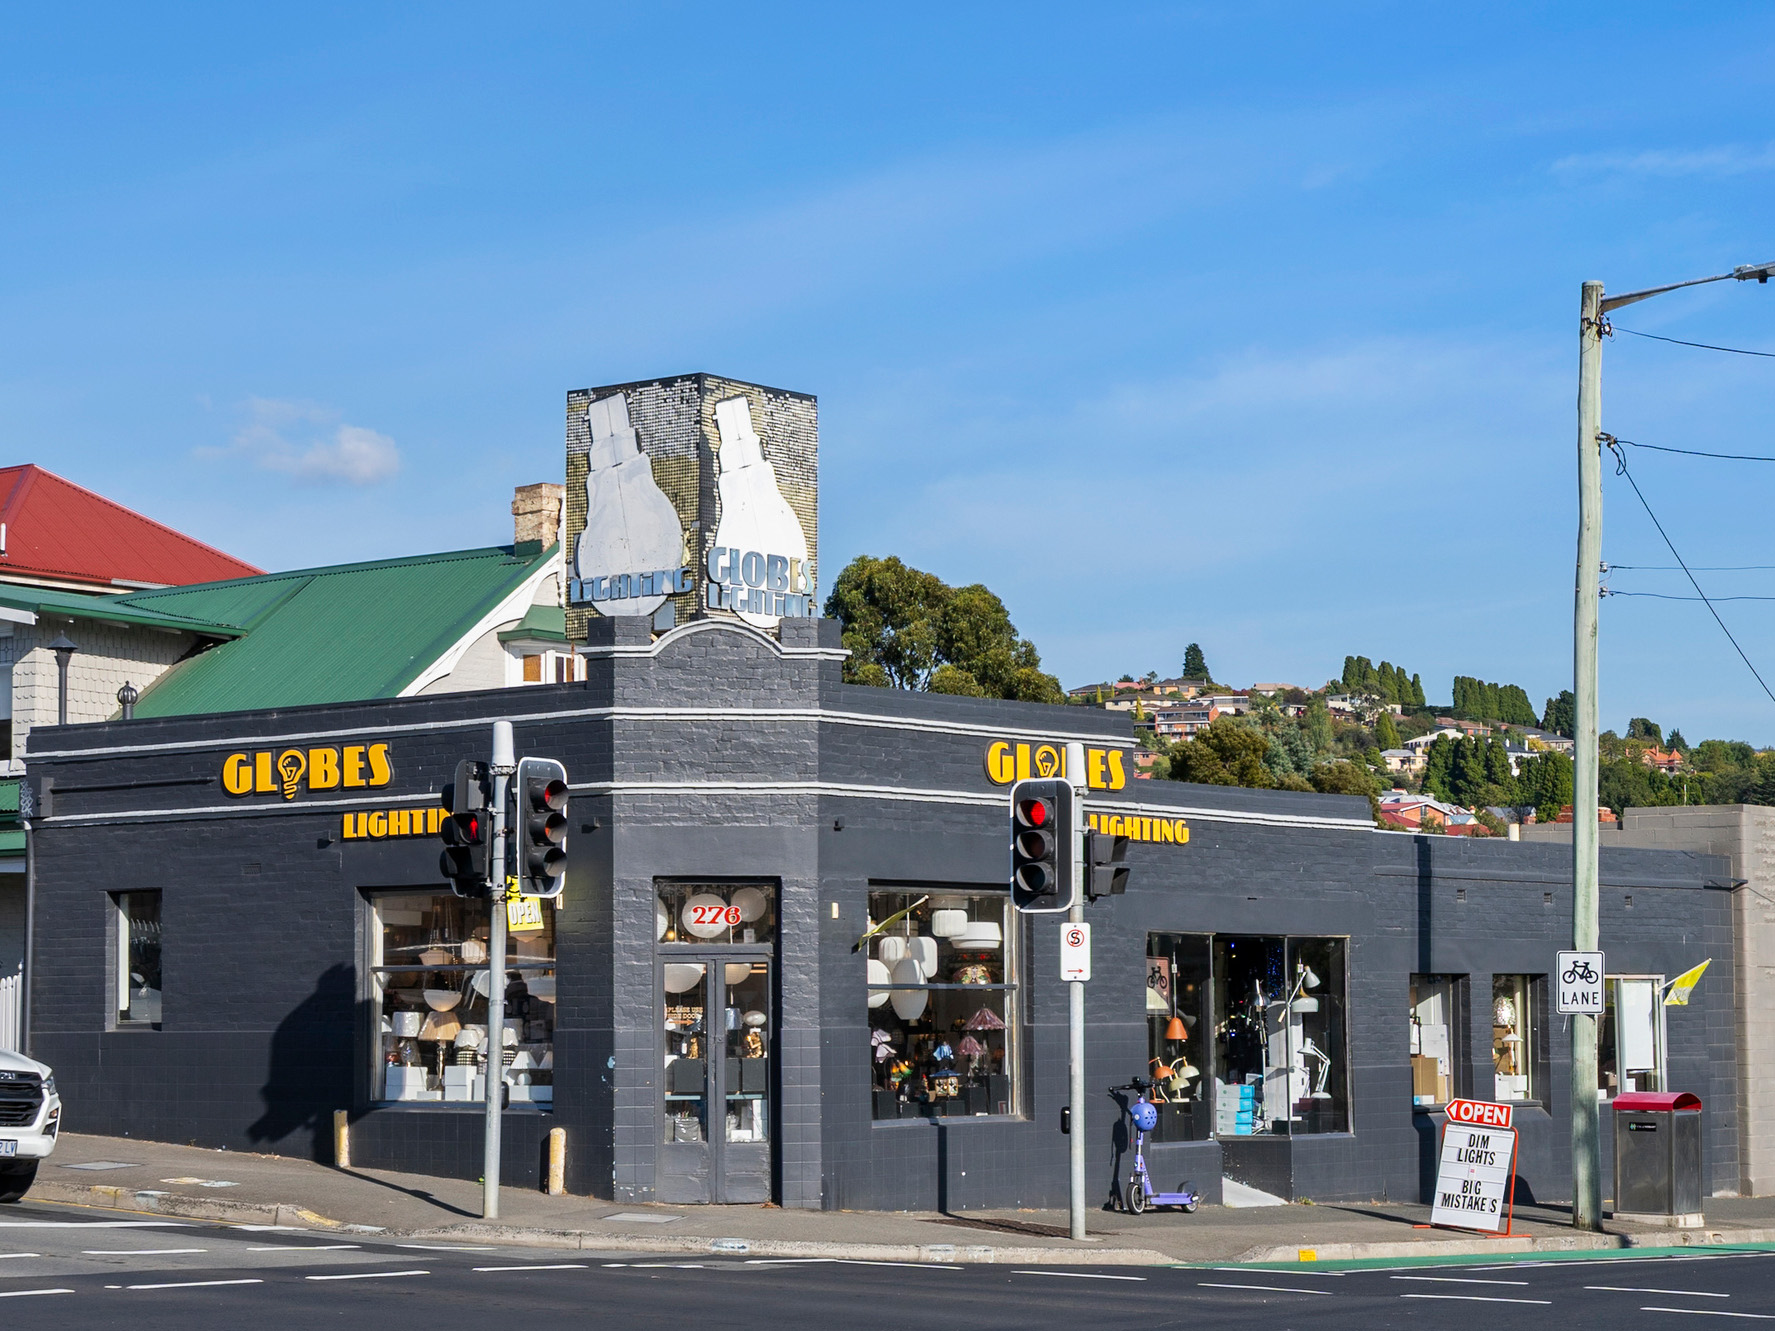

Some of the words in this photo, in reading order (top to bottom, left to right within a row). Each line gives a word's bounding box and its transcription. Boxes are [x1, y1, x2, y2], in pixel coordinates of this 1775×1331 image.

[708, 547, 816, 595] GLOBES
[223, 744, 391, 799] GLOBES
[987, 741, 1126, 790] GLOES
[1089, 814, 1190, 844] LIGHTING
[508, 901, 541, 925] OPEN
[692, 906, 741, 925] 276
[1562, 991, 1599, 1005] LANE
[1460, 1102, 1508, 1125] OPEN
[1468, 1133, 1490, 1149] DIM
[1457, 1148, 1496, 1166] LIGHTS
[1461, 1180, 1482, 1195] BIG
